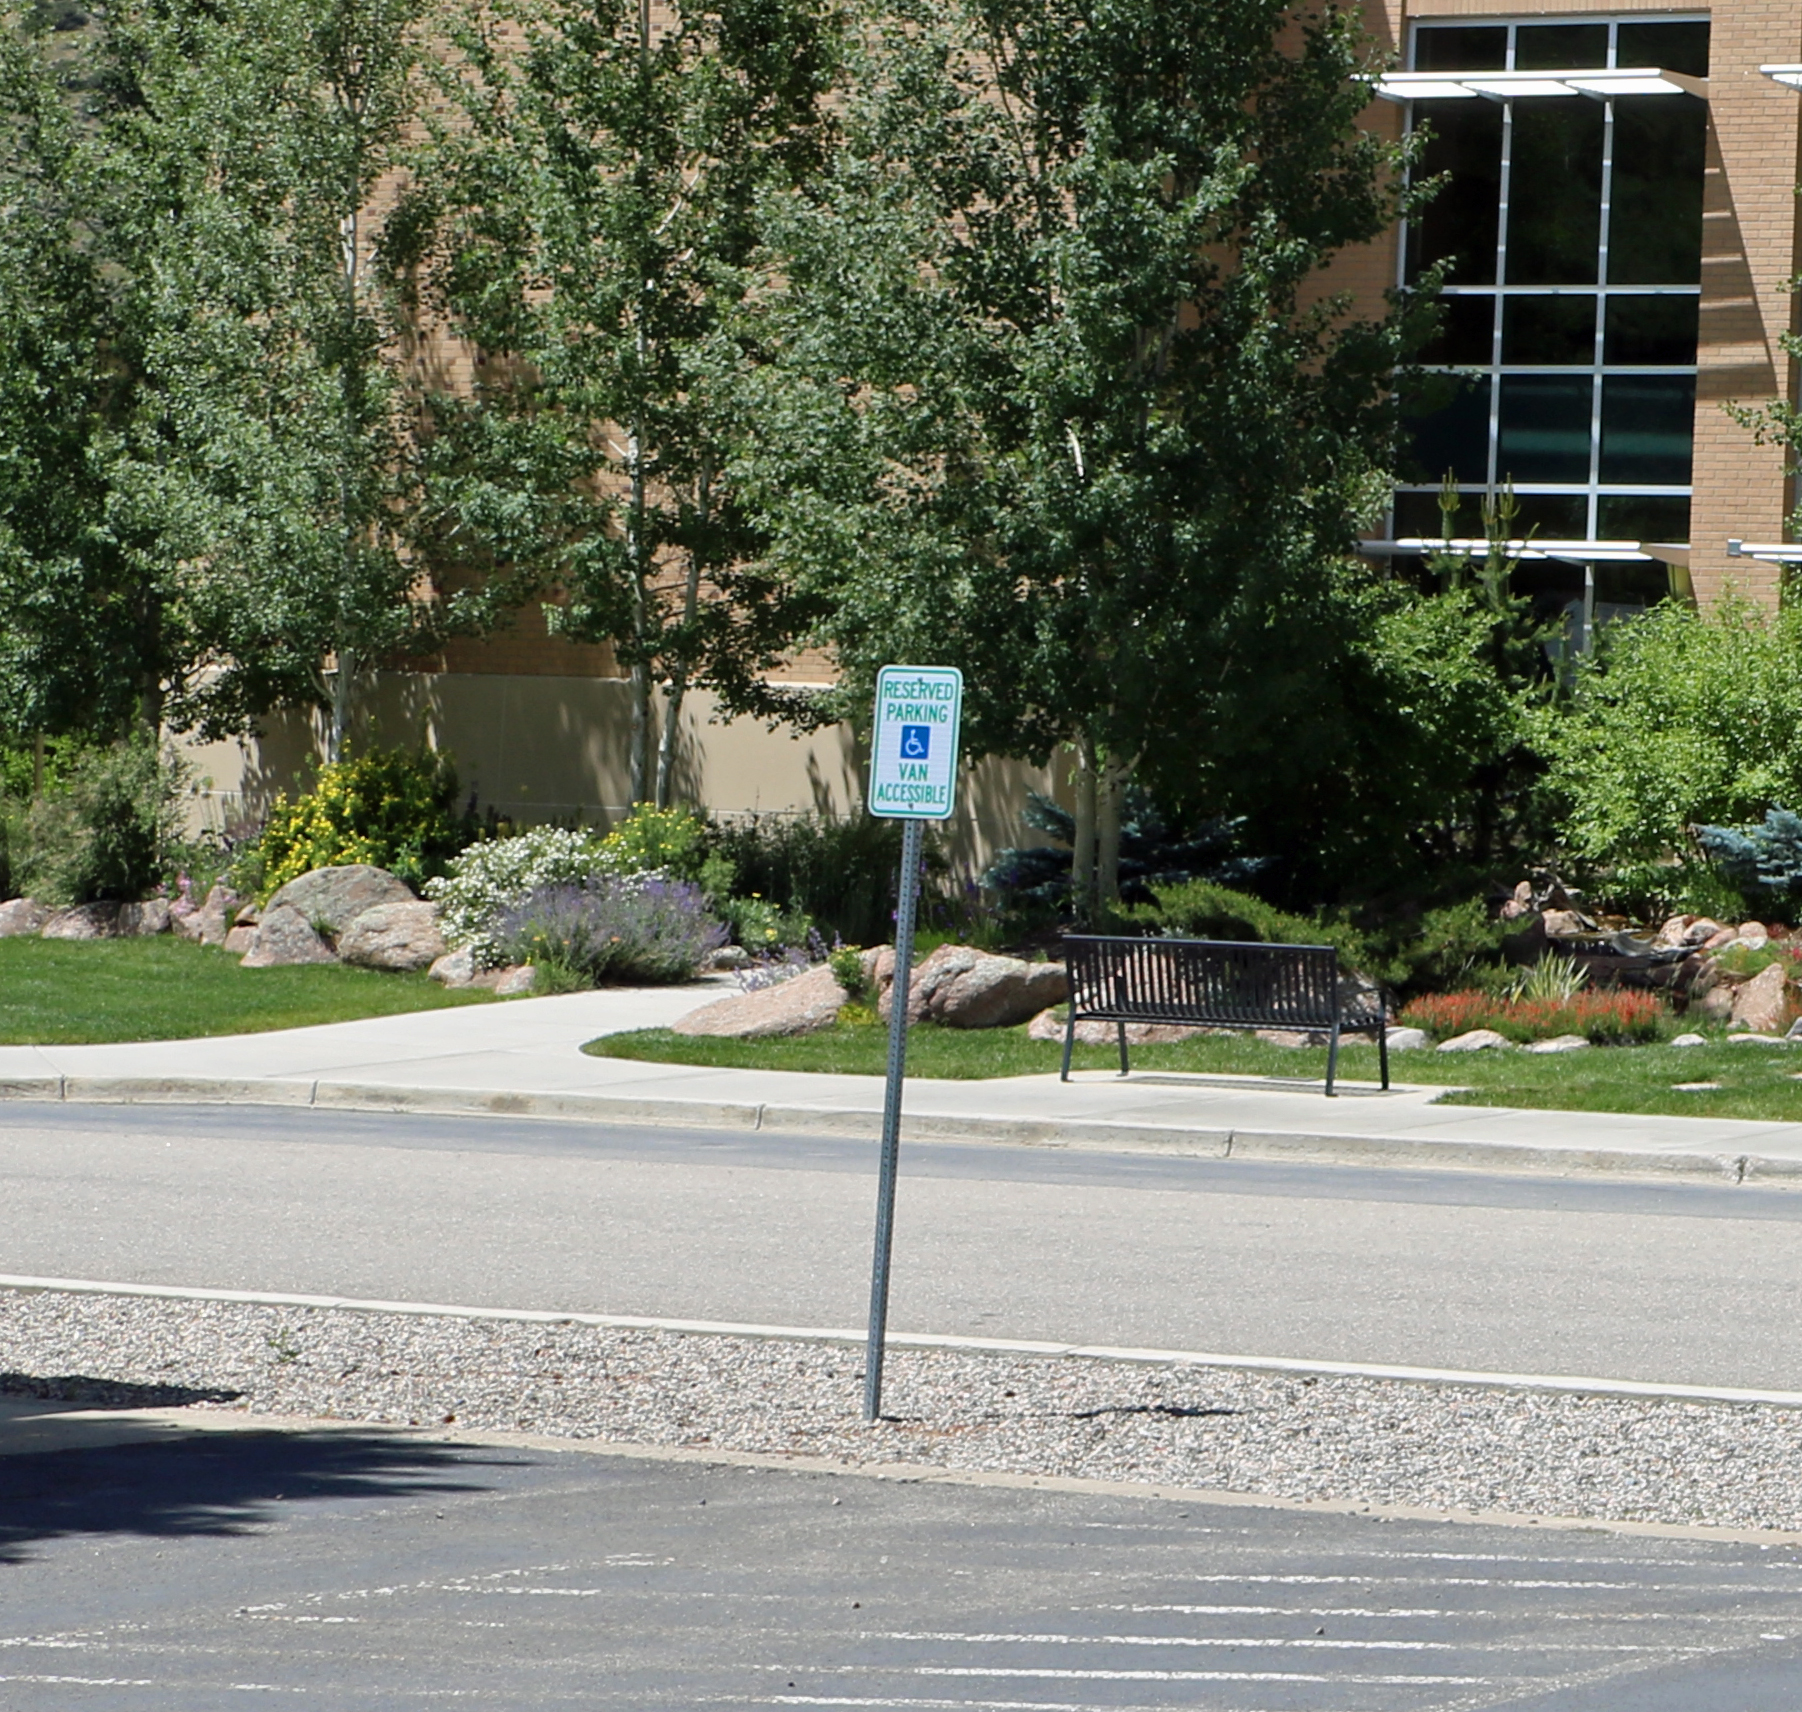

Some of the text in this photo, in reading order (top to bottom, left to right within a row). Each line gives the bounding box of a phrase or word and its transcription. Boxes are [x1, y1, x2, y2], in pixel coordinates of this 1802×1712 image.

[884, 681, 954, 700] RESERVED
[886, 703, 948, 723] PARKING
[898, 763, 929, 781] VAN
[876, 784, 946, 804] ACCESSIBLE
